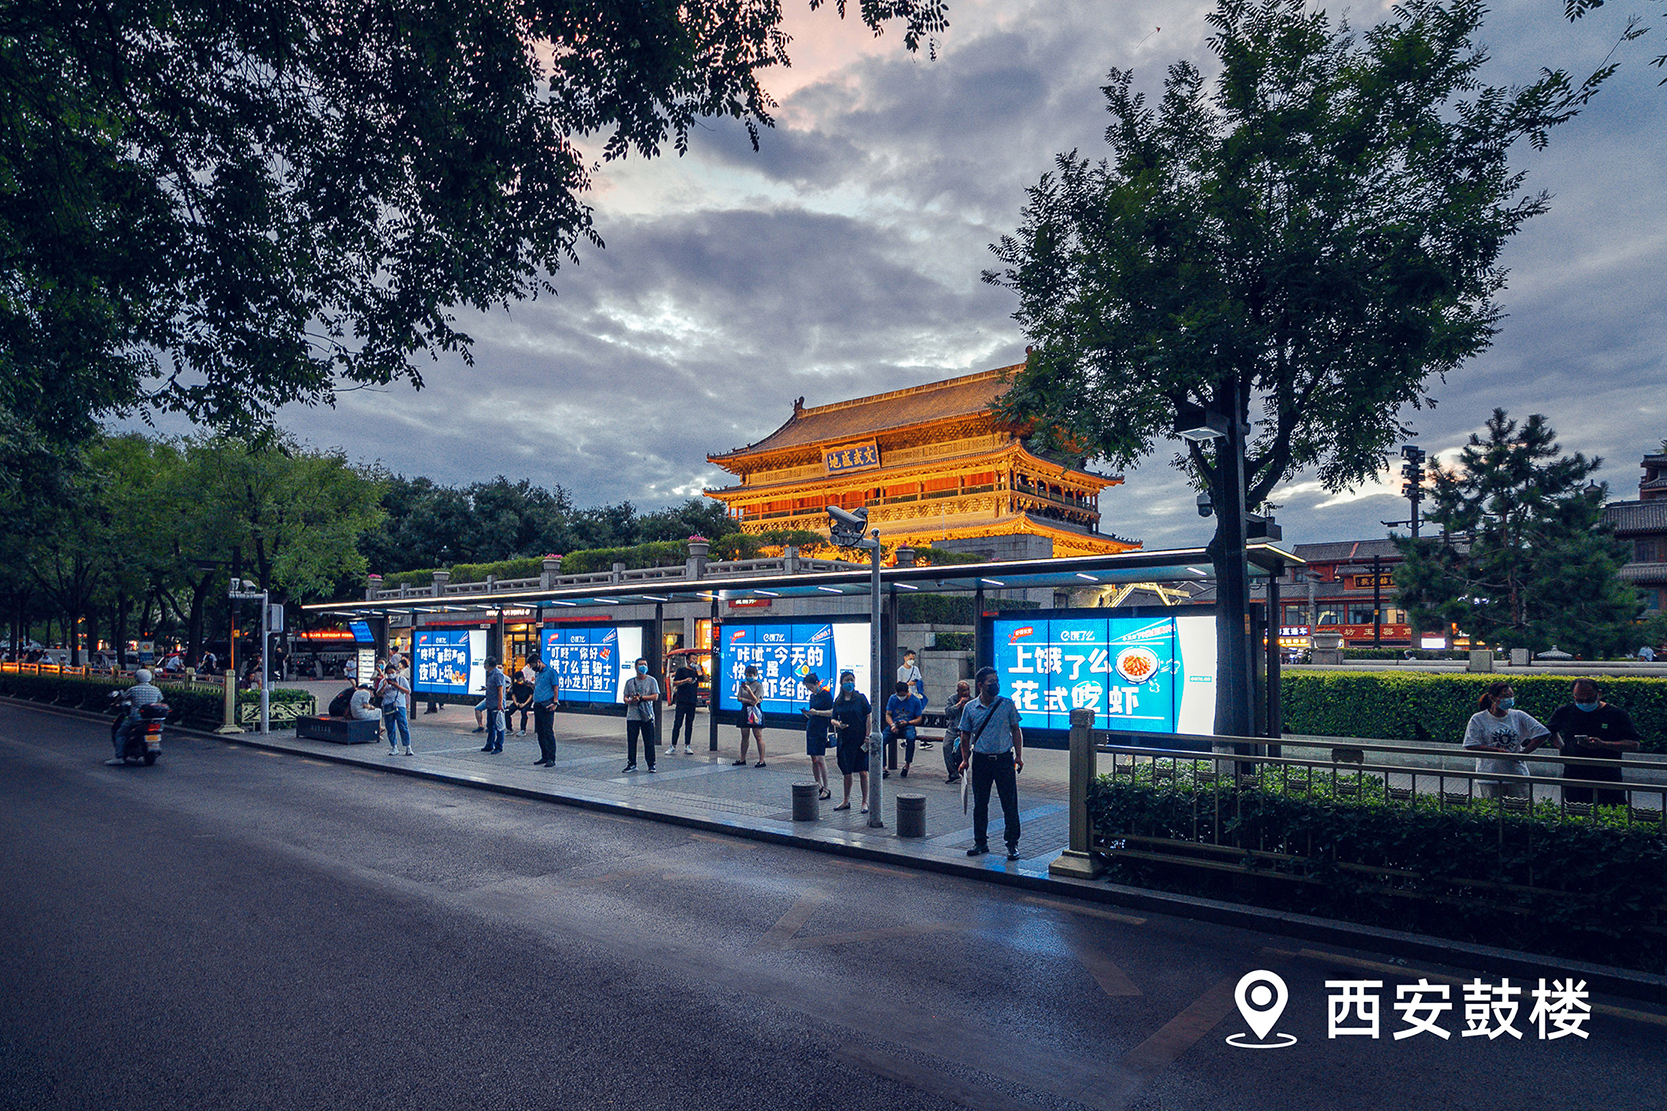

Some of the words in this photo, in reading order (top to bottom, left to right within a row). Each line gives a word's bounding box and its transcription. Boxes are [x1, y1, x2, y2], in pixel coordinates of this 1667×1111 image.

[1007, 645, 1113, 681] 上饿了么
[731, 676, 812, 700] 小虾给的
[1010, 680, 1140, 716] 花式吃虾
